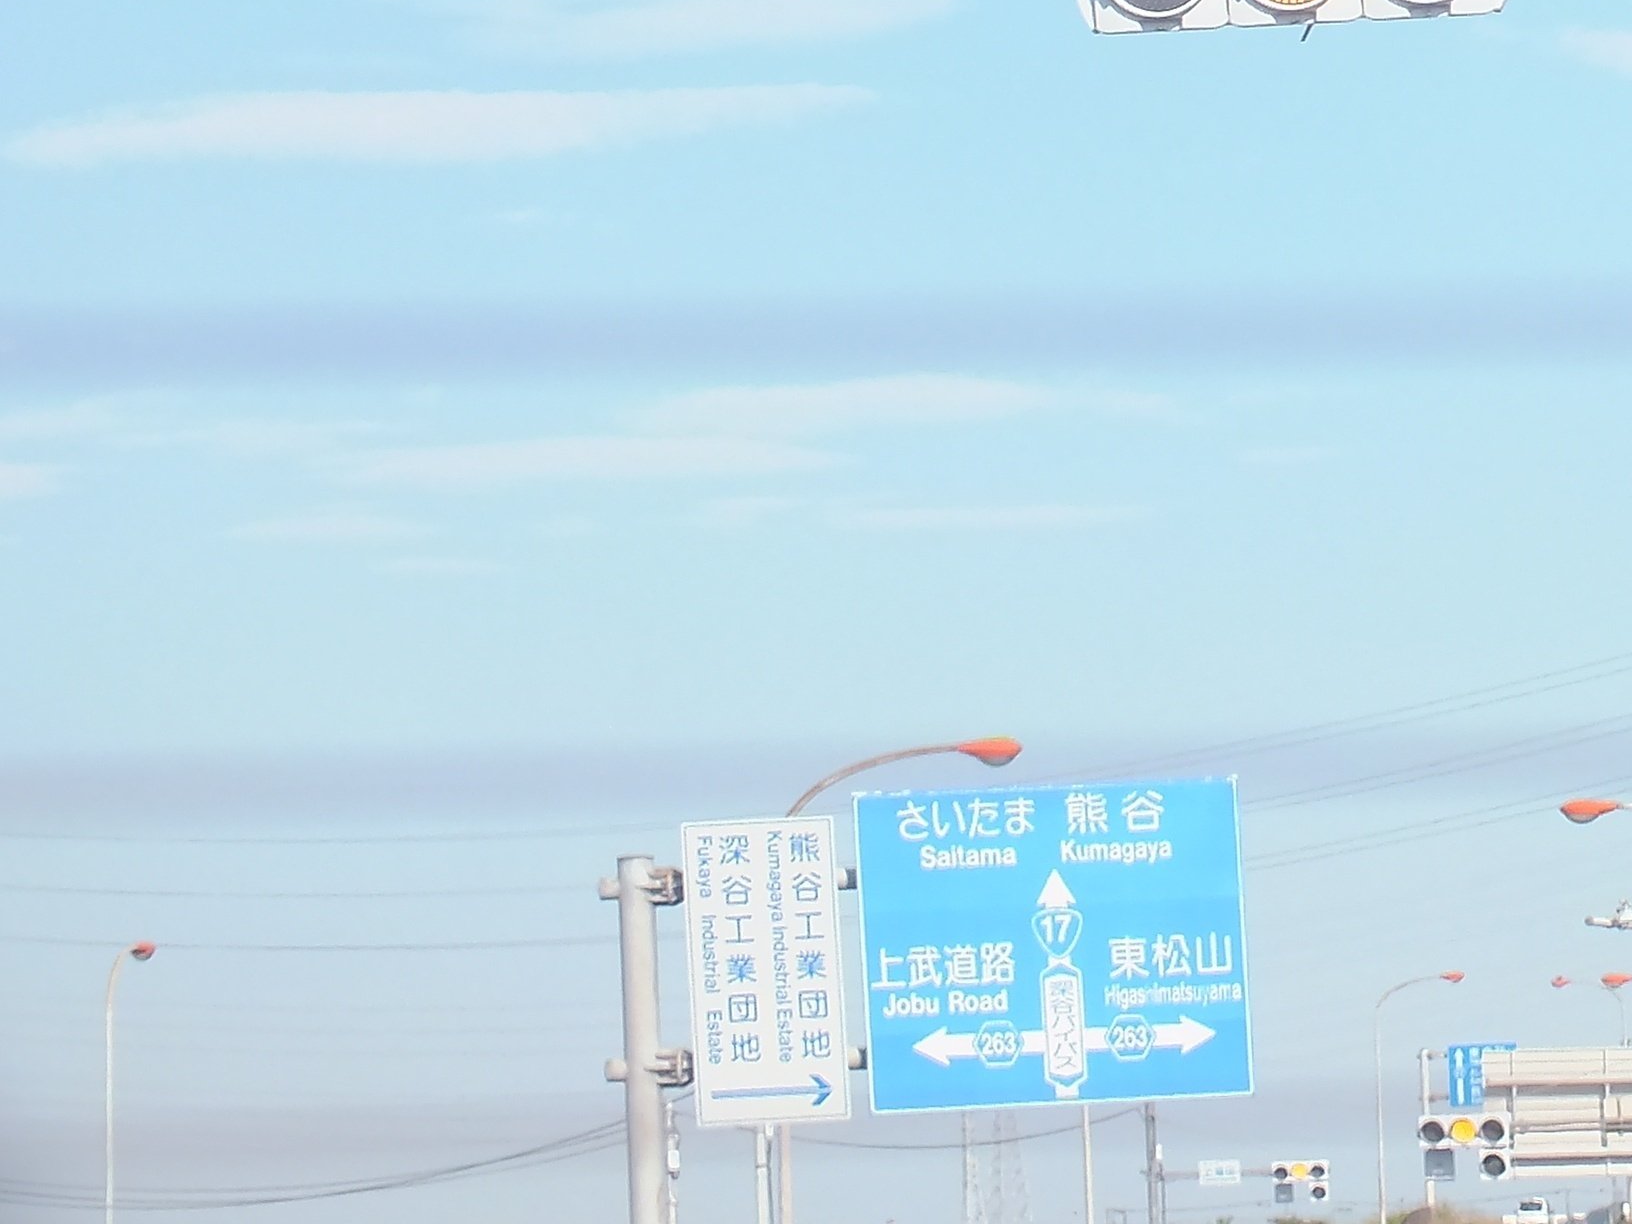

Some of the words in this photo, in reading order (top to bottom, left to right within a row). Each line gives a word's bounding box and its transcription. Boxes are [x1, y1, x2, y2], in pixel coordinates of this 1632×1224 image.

[896, 797, 1036, 841] さいたま
[1065, 790, 1164, 834] 熊谷
[696, 835, 713, 899] Fukaya
[766, 830, 783, 923] Kumagaya
[920, 844, 1017, 870] Saitama
[1060, 839, 1172, 863] Kumagaya
[699, 914, 720, 994] Industrial
[719, 834, 762, 1063] 深谷工業団地
[788, 832, 831, 1059] 熊谷工業団地
[1040, 915, 1071, 944] 17
[1109, 932, 1233, 979] 東松山
[771, 926, 791, 1009] Industrial
[872, 941, 1016, 989] 上武道路
[883, 993, 940, 1017] Jobu
[948, 989, 1009, 1013] Road
[1050, 980, 1077, 1069] 深谷バイパス
[706, 1009, 724, 1065] Estate
[777, 1009, 794, 1063] Estate
[982, 1033, 1017, 1056] 263
[1112, 1025, 1147, 1048] 263
